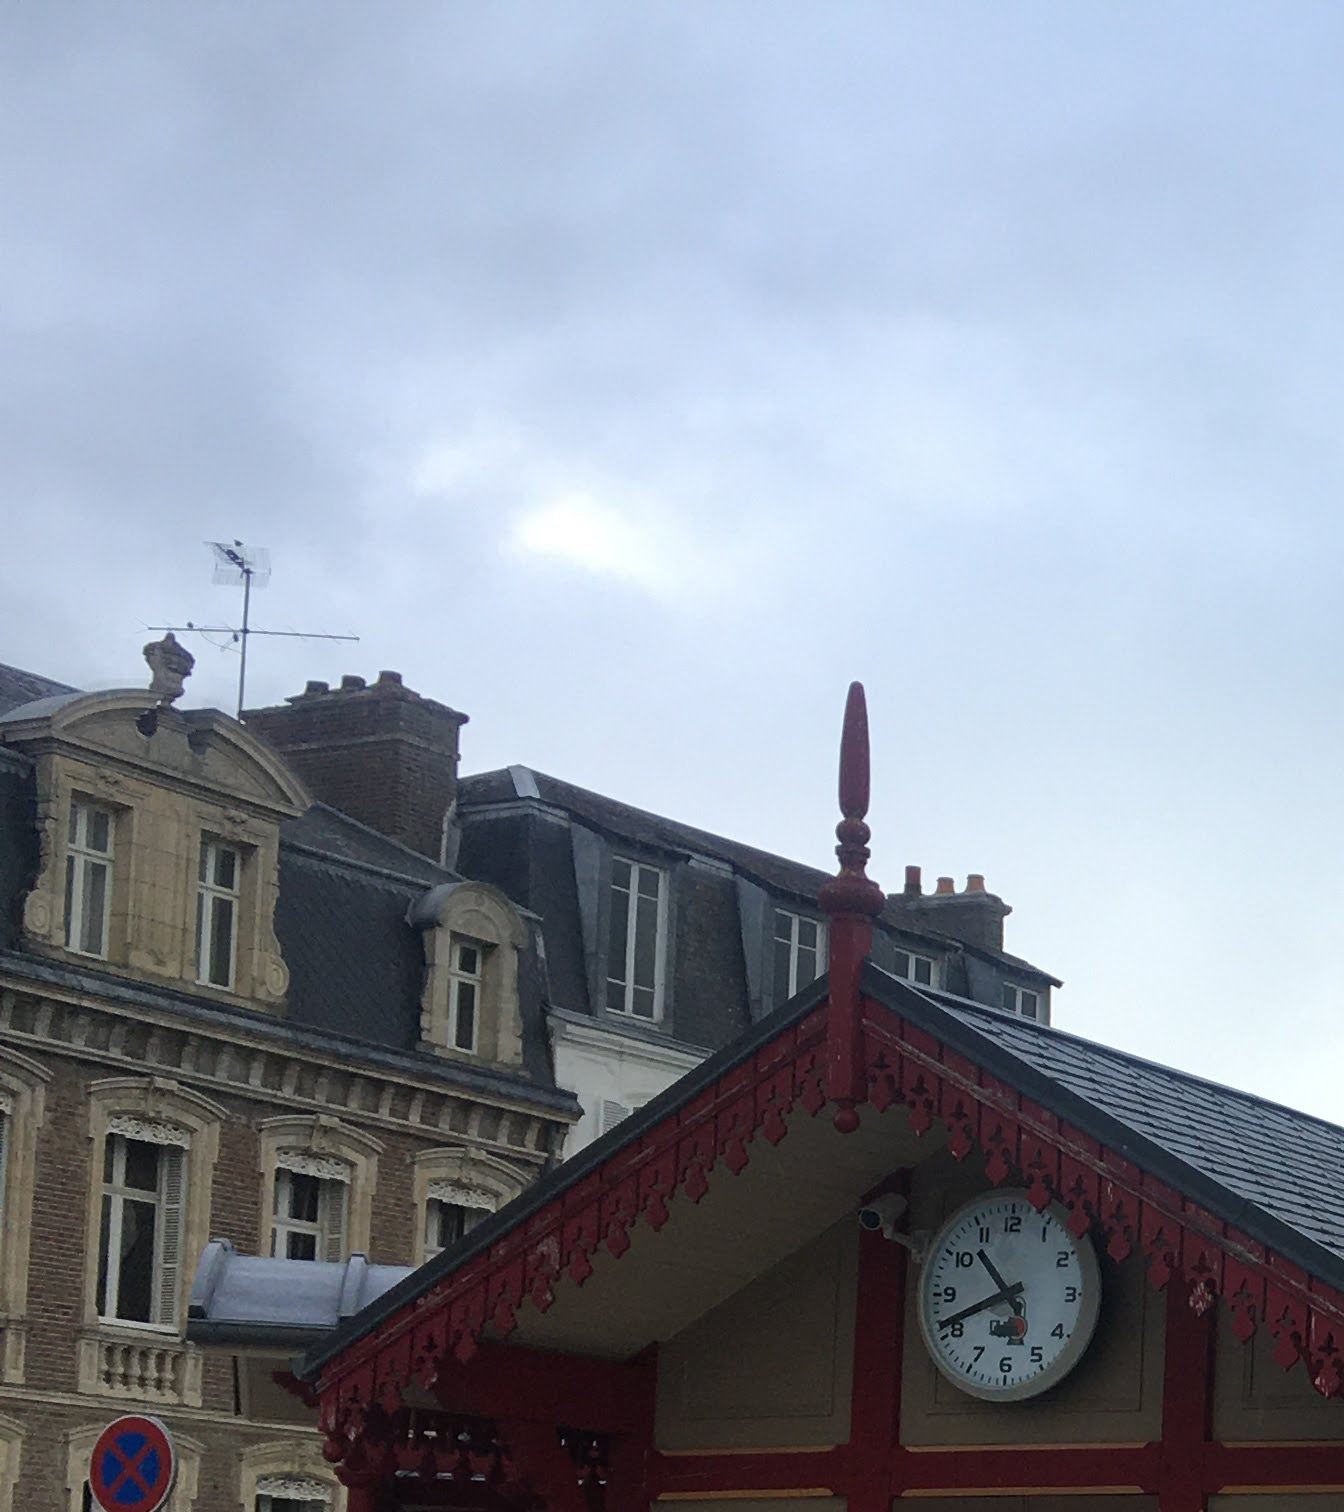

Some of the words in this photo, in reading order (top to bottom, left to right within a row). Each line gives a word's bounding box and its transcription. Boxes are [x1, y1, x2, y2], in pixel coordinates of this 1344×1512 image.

[1004, 1216, 1022, 1233] 12
[979, 1227, 990, 1243] 11
[955, 1252, 974, 1268] 10
[1056, 1252, 1069, 1268] 2
[943, 1287, 957, 1302] 9
[1065, 1287, 1077, 1303] 3
[950, 1322, 964, 1338] 8
[1051, 1323, 1064, 1339] 4
[973, 1346, 985, 1362] 7
[1030, 1347, 1043, 1363] 5
[999, 1357, 1012, 1373] 6
